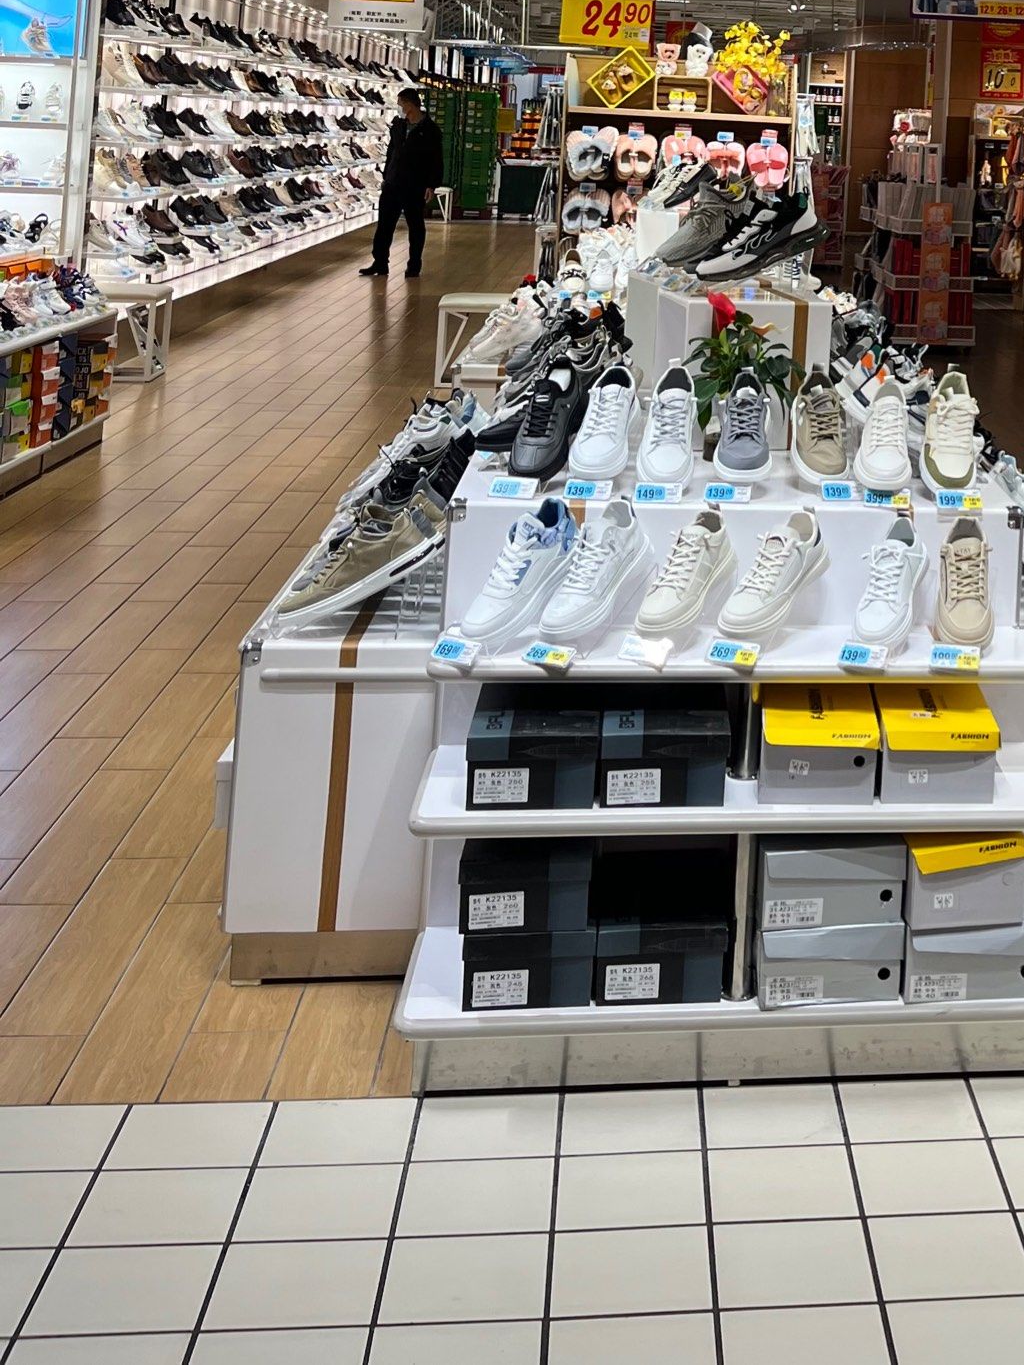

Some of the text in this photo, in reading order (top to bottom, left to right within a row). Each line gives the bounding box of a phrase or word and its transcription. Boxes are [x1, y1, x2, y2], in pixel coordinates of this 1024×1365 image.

[623, 771, 654, 779] K22135
[979, 840, 1017, 853] FASHION
[485, 894, 517, 903] K22135
[622, 966, 653, 974] K22135
[490, 973, 522, 981] K22135
